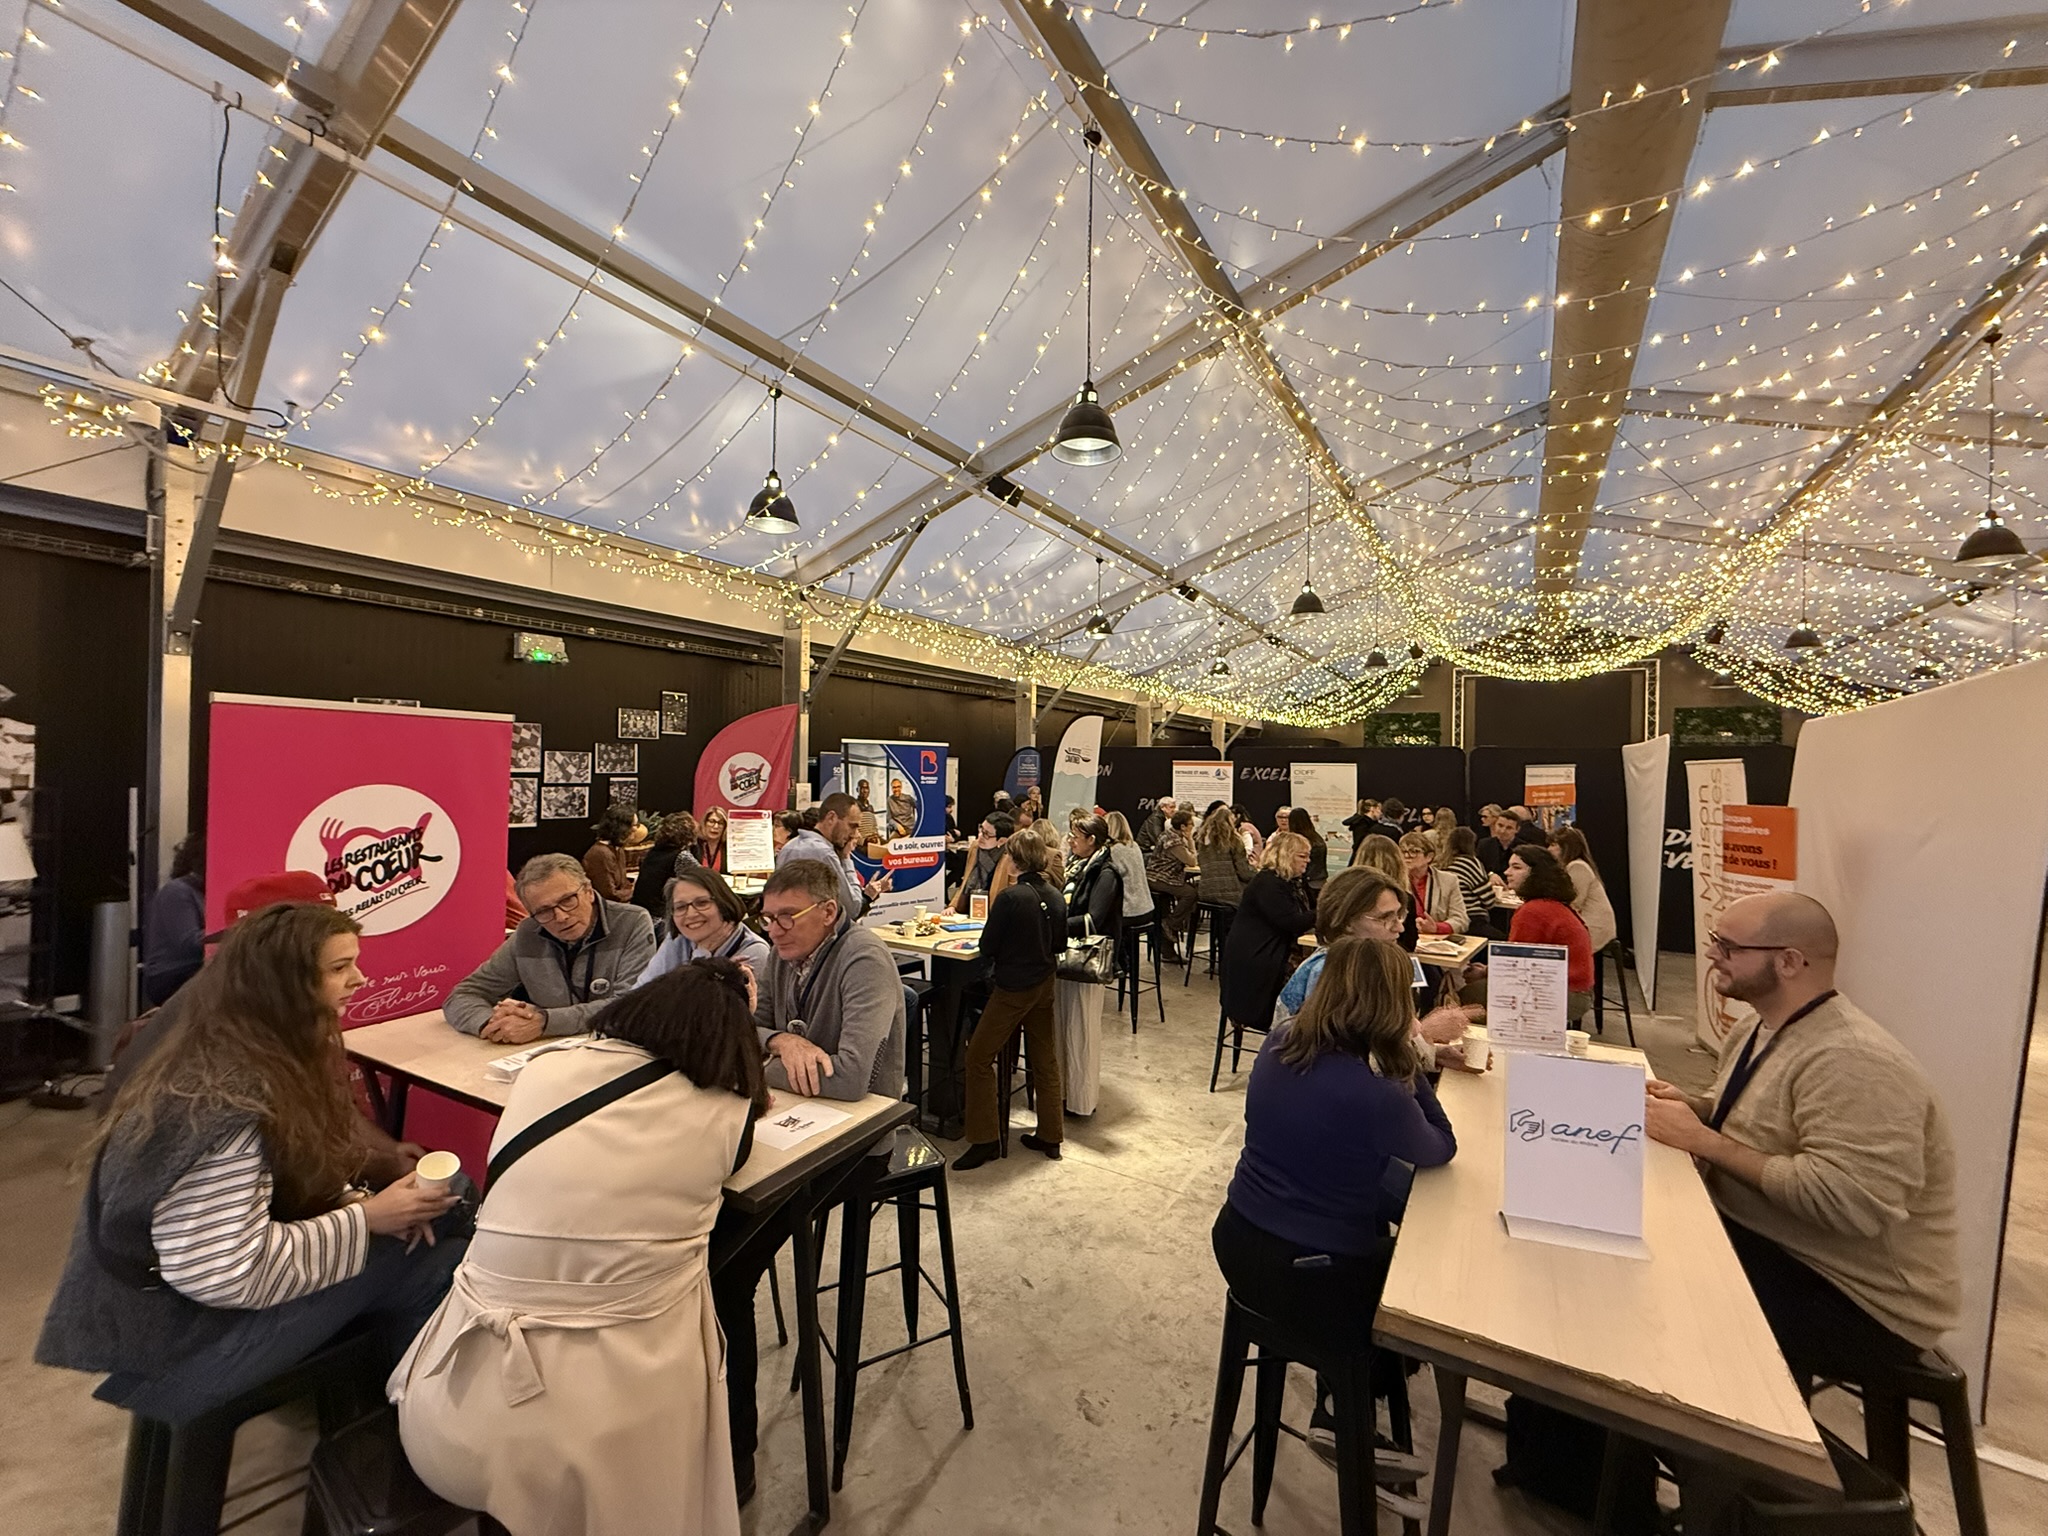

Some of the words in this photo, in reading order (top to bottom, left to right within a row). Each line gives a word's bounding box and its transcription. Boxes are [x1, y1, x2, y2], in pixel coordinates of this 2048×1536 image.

[324, 857, 344, 877] LES
[344, 826, 424, 868] RESTAURANTS
[893, 842, 903, 851] Le
[888, 858, 902, 866] vos
[903, 855, 934, 865] bureaux
[1741, 857, 1770, 869] vous
[327, 872, 351, 894] DU
[355, 893, 385, 912] RELAIS
[1551, 1124, 1642, 1155] anef
